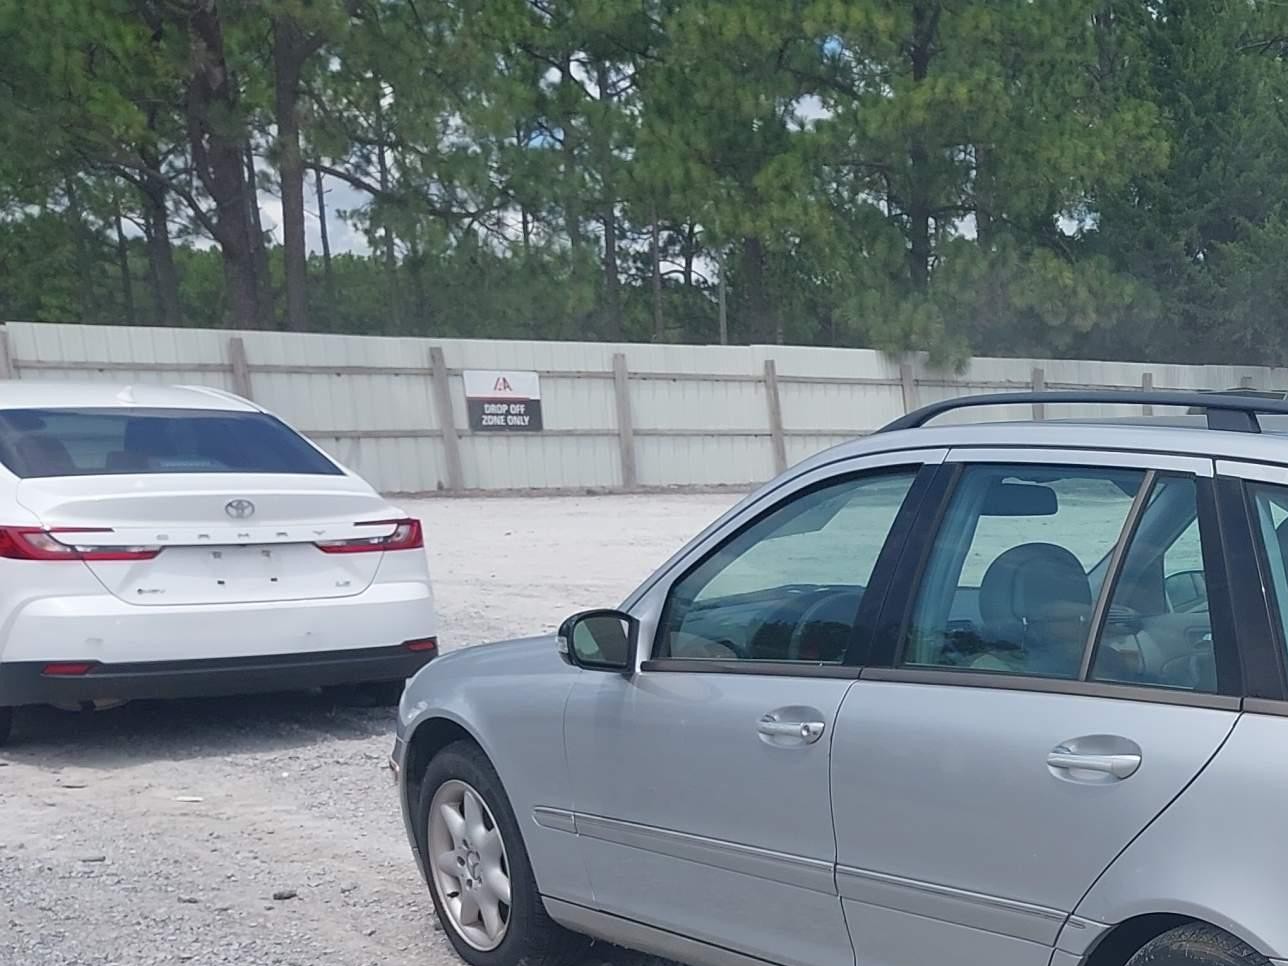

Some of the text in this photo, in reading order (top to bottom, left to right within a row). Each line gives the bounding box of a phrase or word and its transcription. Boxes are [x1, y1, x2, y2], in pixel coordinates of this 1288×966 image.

[483, 403, 526, 415] DROP OFF
[481, 414, 530, 426] ZONE ONLY
